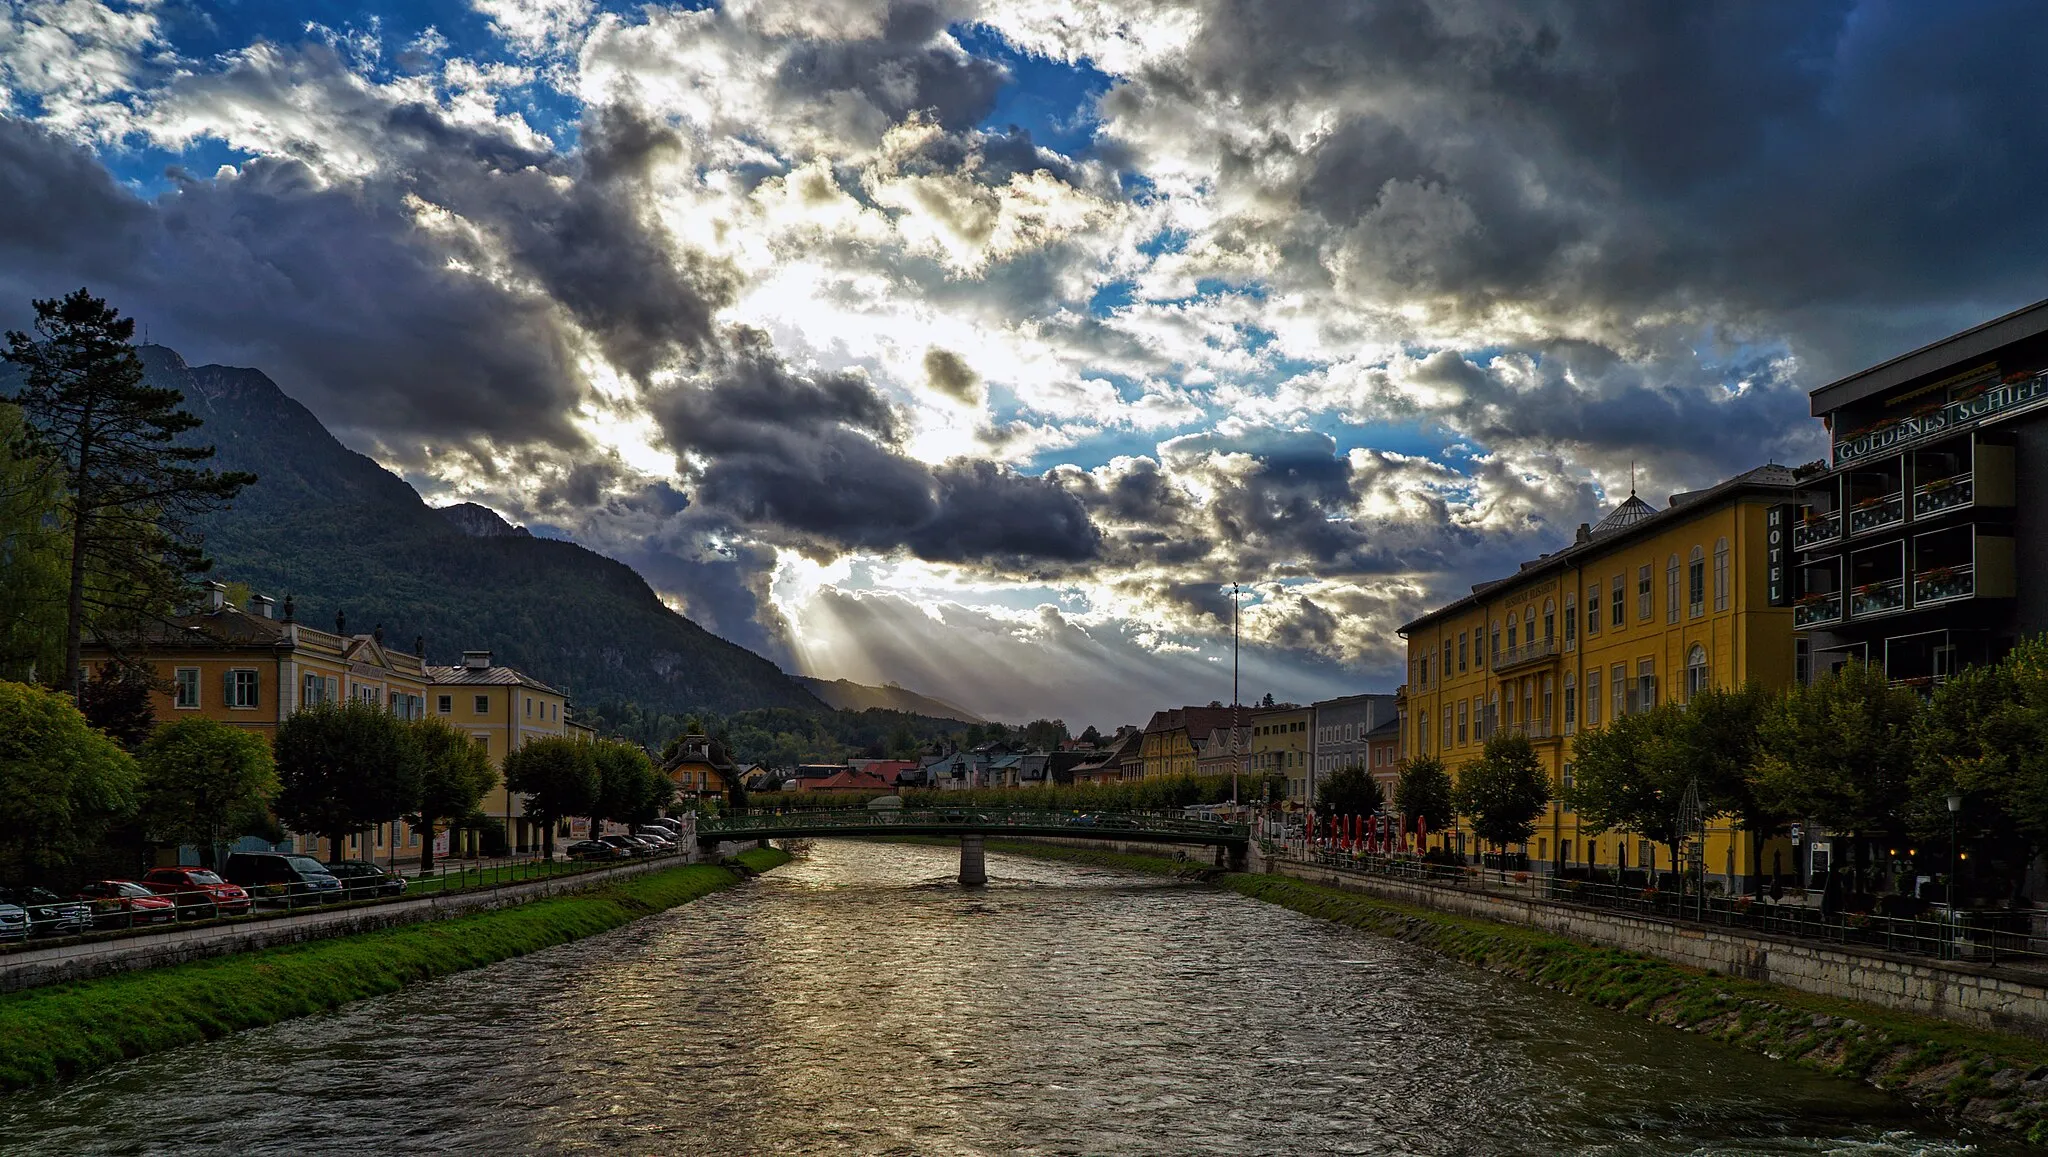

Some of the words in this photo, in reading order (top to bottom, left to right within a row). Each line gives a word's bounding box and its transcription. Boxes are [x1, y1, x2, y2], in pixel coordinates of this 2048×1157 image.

[1840, 415, 1945, 459] GOLDENES
[1959, 378, 2042, 420] SCHIFF
[1768, 511, 1780, 600] HOTEL
